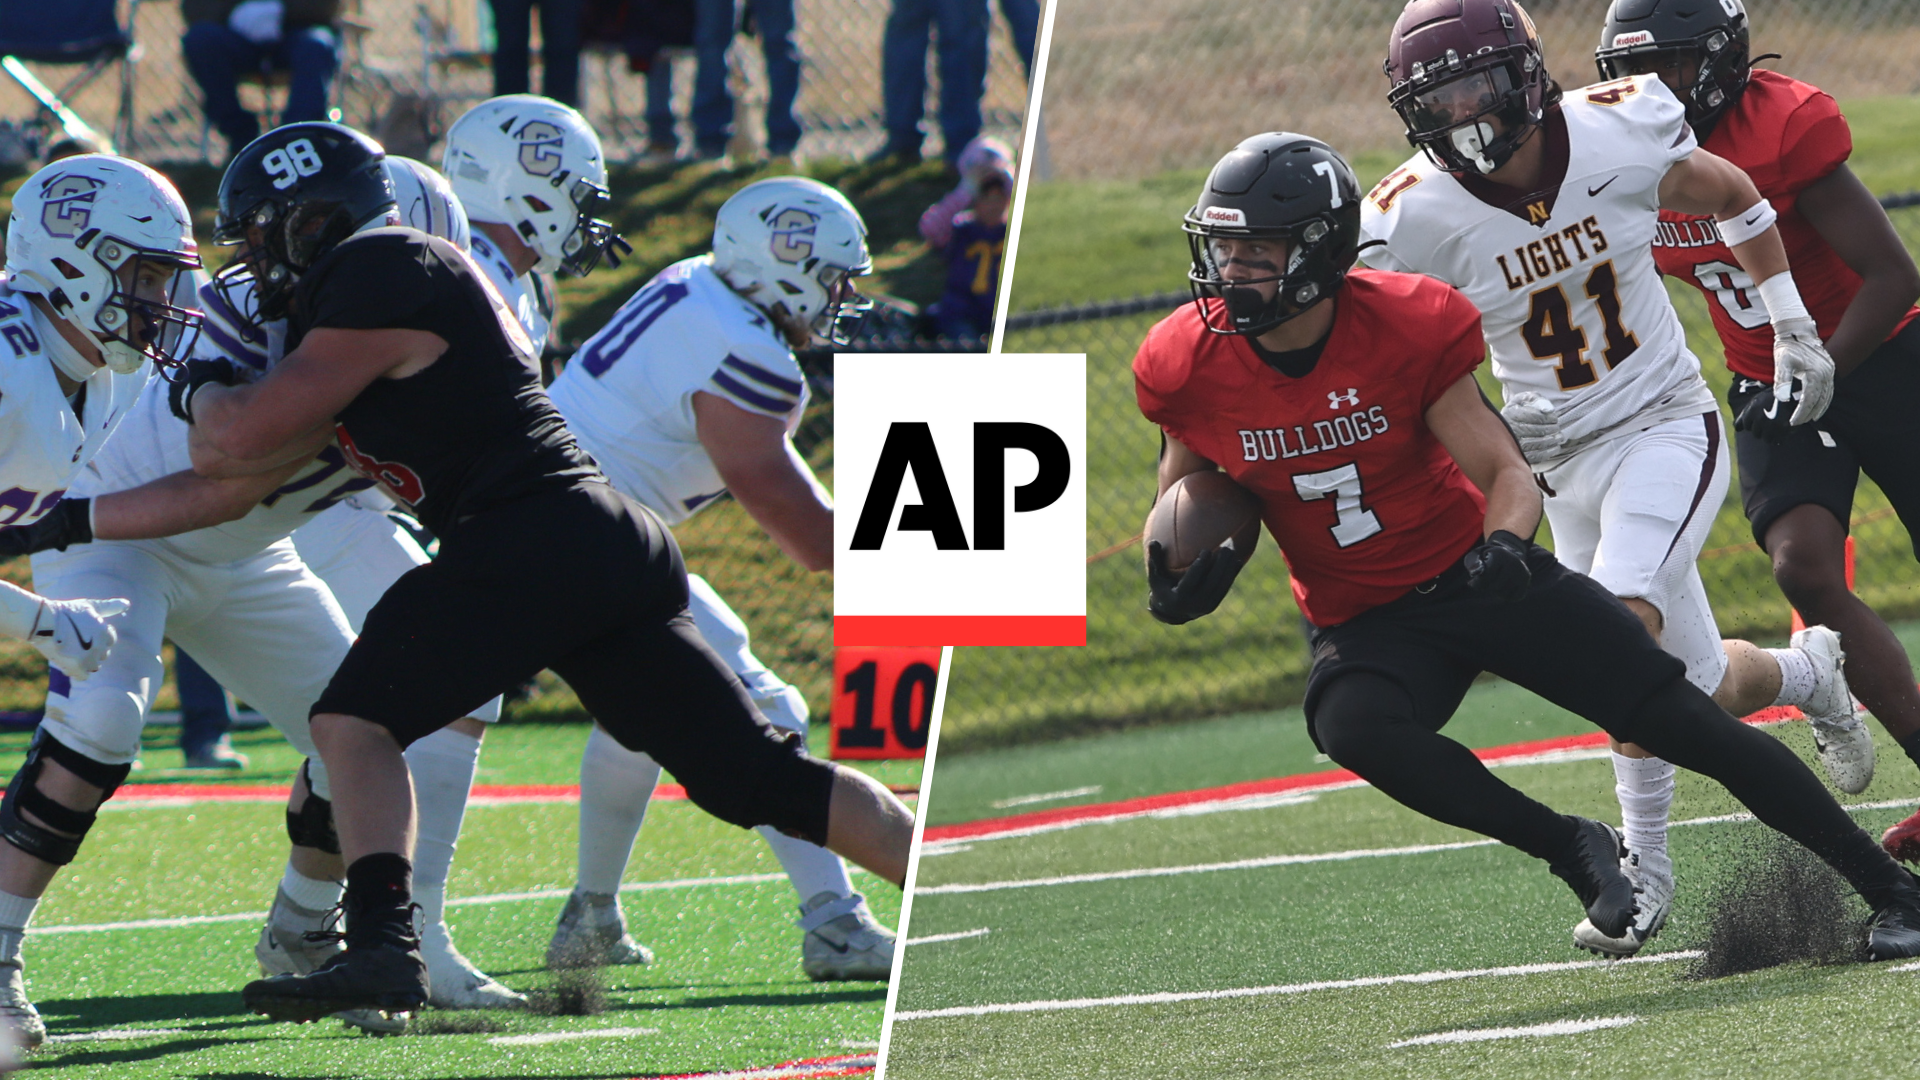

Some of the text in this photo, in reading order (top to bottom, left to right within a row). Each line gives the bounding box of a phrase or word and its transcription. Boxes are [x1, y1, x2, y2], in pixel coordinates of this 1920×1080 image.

[1616, 33, 1647, 46] Riddell
[262, 138, 323, 190] 98
[1311, 161, 1342, 209] 7
[1205, 210, 1239, 222] Riddell
[1526, 201, 1549, 223] N
[1653, 219, 1724, 247] ULLD
[1496, 215, 1608, 291] LIGHTS
[1520, 259, 1641, 391] 41
[1238, 405, 1389, 462] BULLDOGS
[1291, 462, 1383, 549] 7
[837, 660, 939, 750] 10
